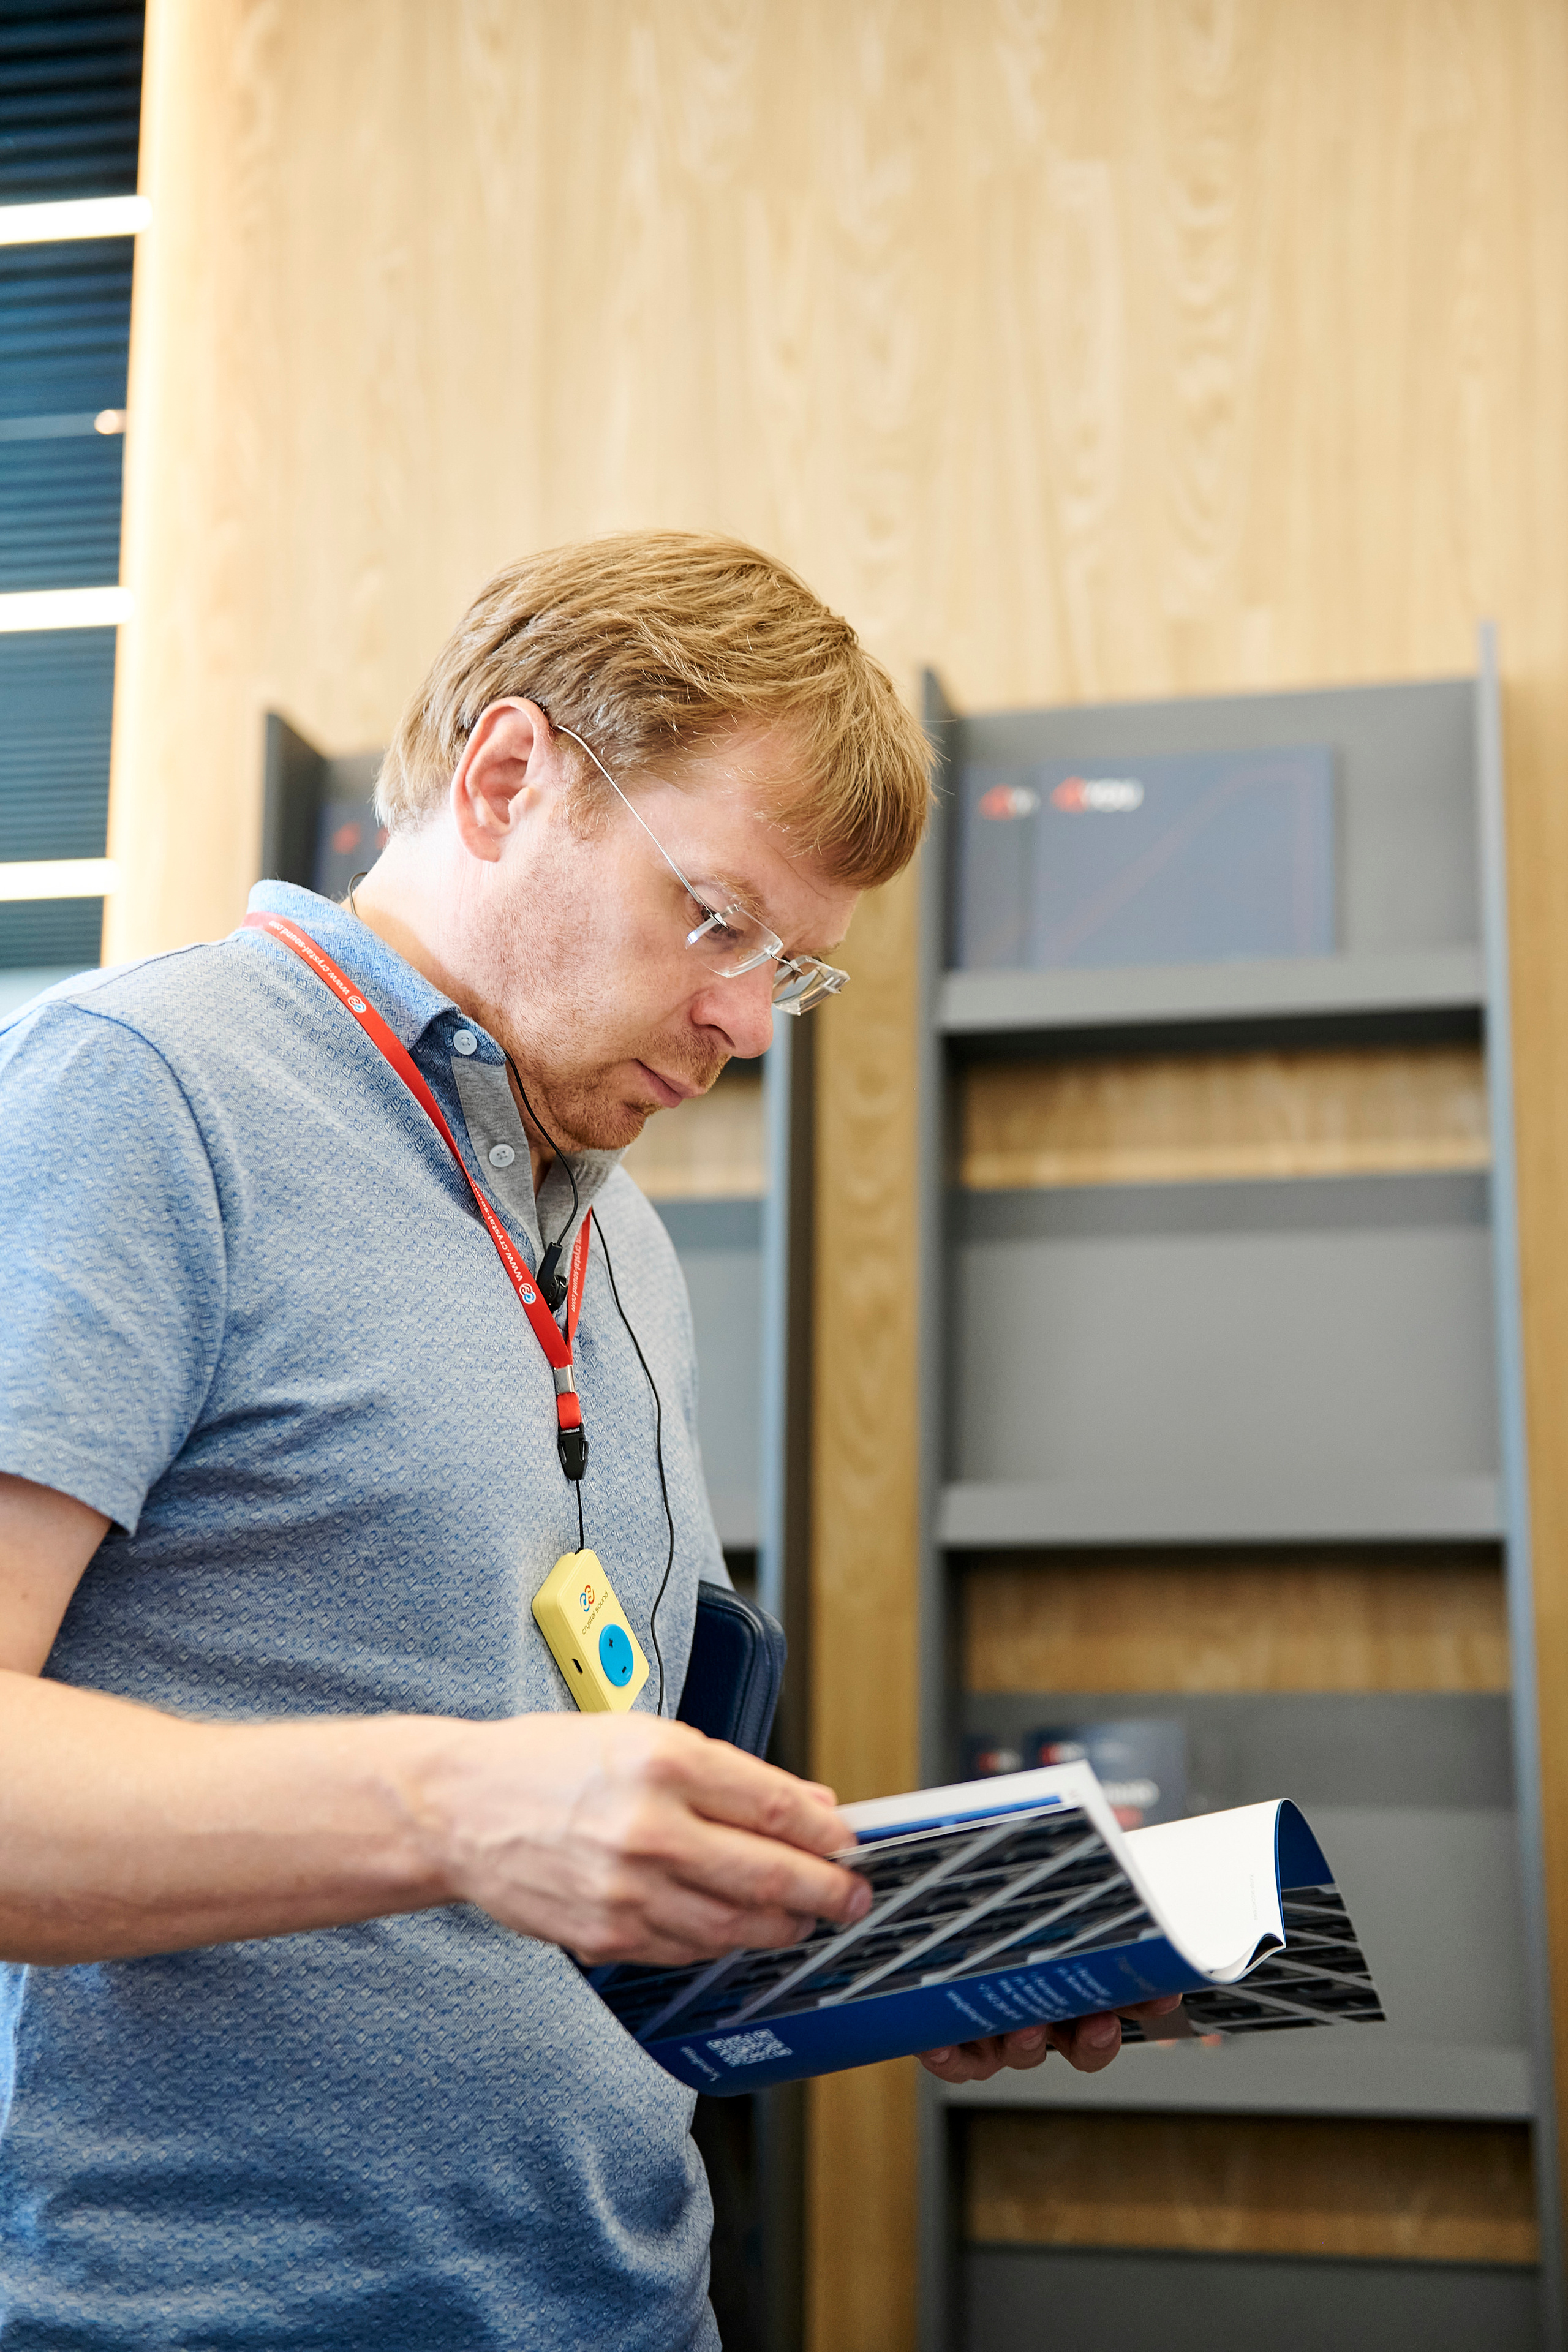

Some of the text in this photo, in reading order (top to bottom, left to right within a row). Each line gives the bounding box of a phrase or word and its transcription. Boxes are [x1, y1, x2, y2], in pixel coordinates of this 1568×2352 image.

[269, 920, 350, 995] www.crystal-sound.com
[582, 1590, 608, 1635] crystal sound
